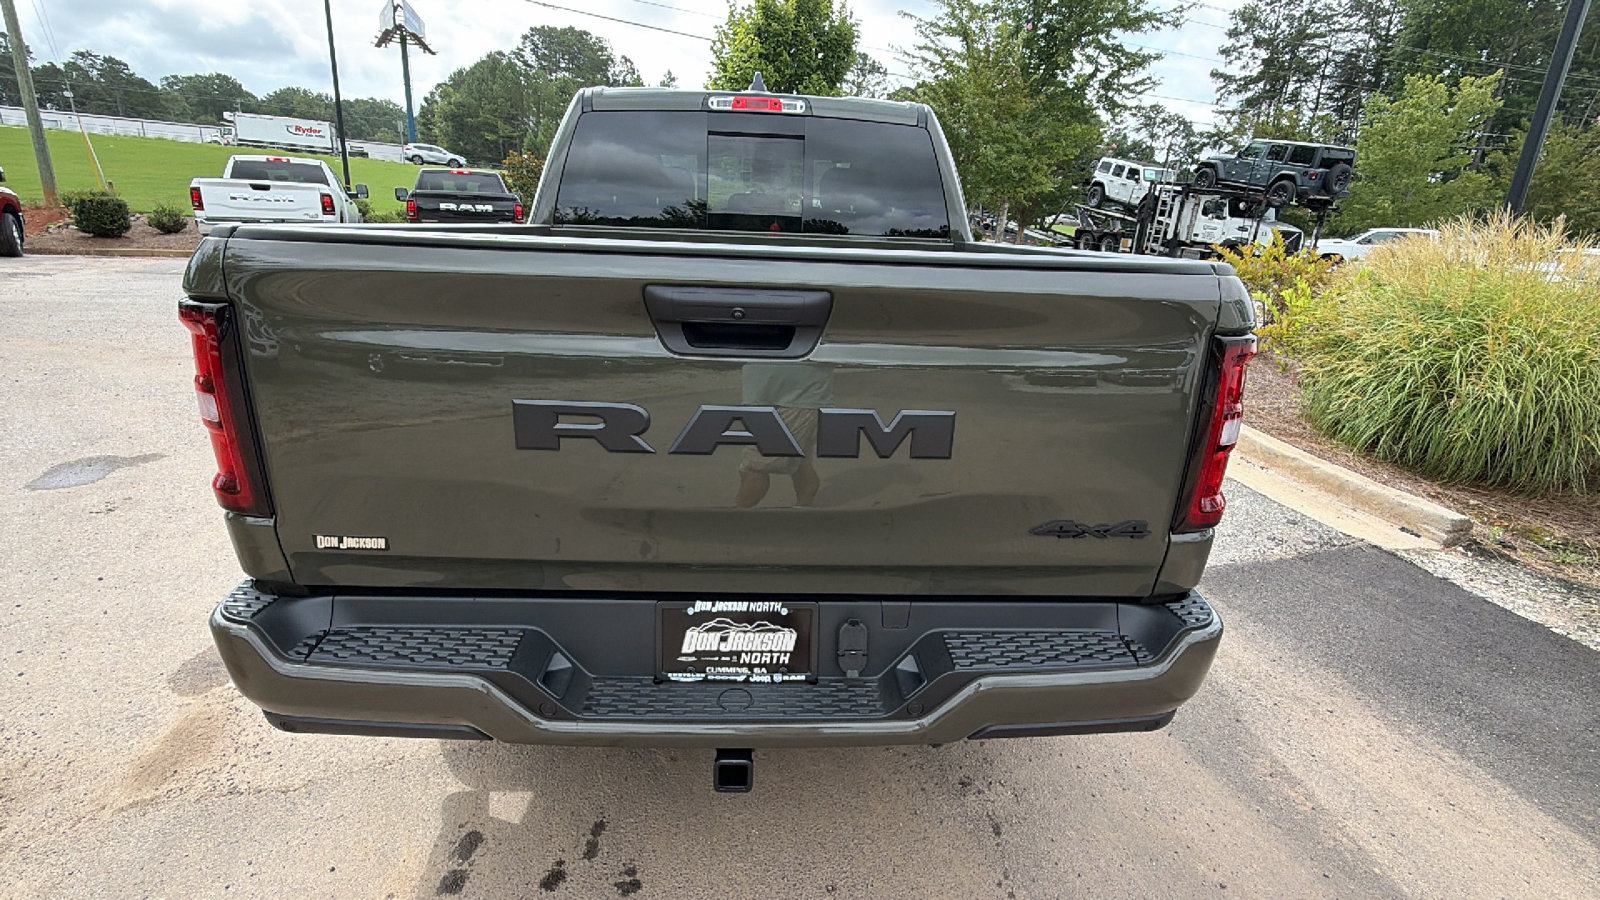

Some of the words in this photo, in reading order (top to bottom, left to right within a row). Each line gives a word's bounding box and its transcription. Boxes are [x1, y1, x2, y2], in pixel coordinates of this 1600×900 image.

[295, 125, 322, 134] Ryder
[229, 193, 295, 203] RAM
[439, 202, 493, 213] RAM
[512, 398, 956, 460] RAM
[1028, 519, 1152, 539] 4x4
[316, 535, 339, 549] DON
[340, 536, 386, 549] JACKSON
[749, 601, 783, 612] NORTH
[681, 630, 720, 654] DON
[719, 630, 797, 652] JACKSON
[740, 652, 791, 664] NORTH
[749, 674, 772, 683] Jeep
